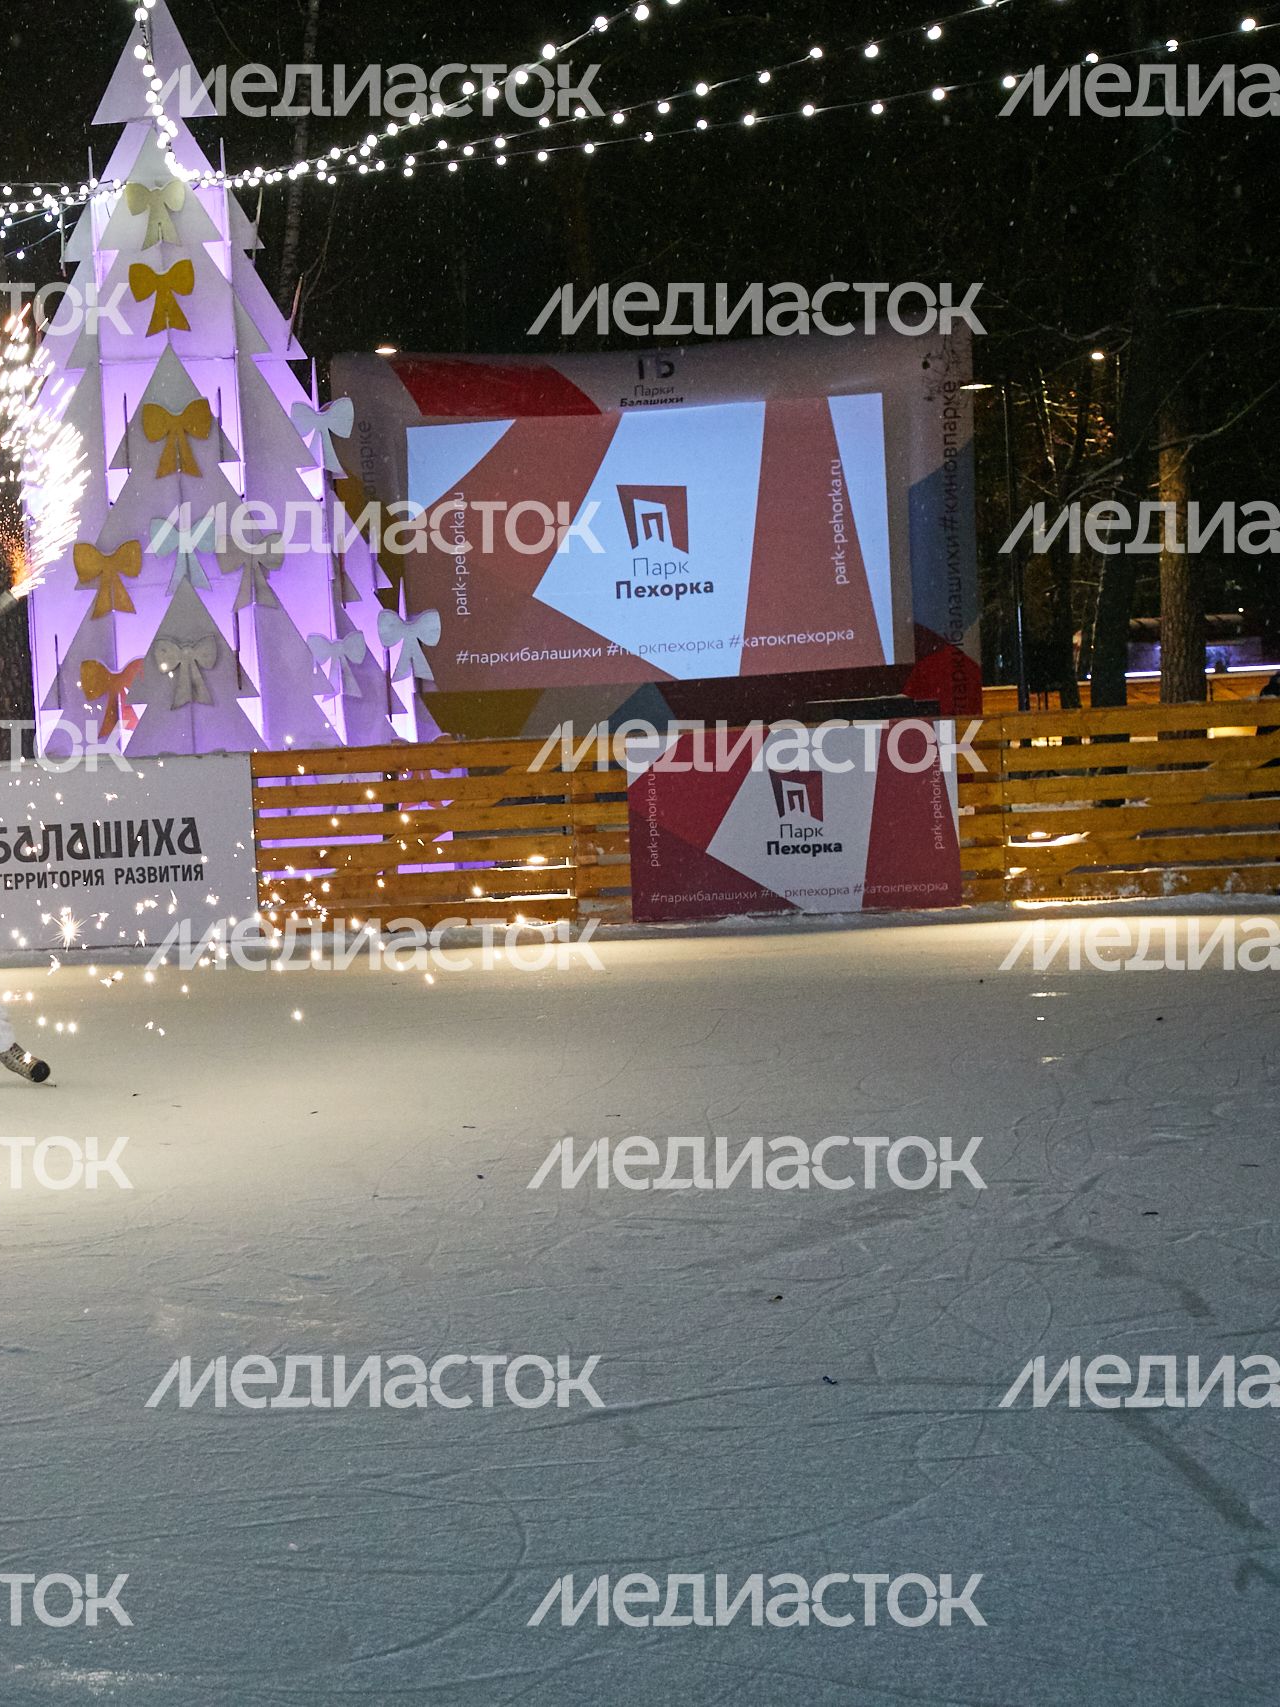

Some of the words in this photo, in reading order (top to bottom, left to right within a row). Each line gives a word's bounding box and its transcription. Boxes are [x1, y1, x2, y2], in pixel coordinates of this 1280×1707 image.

[620, 397, 684, 407] Балашихи
[634, 385, 674, 398] Парки
[829, 458, 851, 586] park-pehorka.ru
[450, 492, 471, 616] park-pehorka.ru
[632, 556, 691, 578] Парк
[615, 579, 715, 600] Пехорка
[455, 645, 602, 666] #паркибалашихи
[606, 637, 724, 658] #пркпехорка
[728, 626, 855, 648] #катокпехорка
[647, 772, 661, 869] park-pehorka.ru
[779, 823, 824, 842] Парк
[766, 840, 843, 858] Пехорка
[114, 863, 205, 885] РАЗВИТИЯ
[650, 888, 757, 905] #паркибалашихи
[761, 885, 850, 899] #пркпехорка
